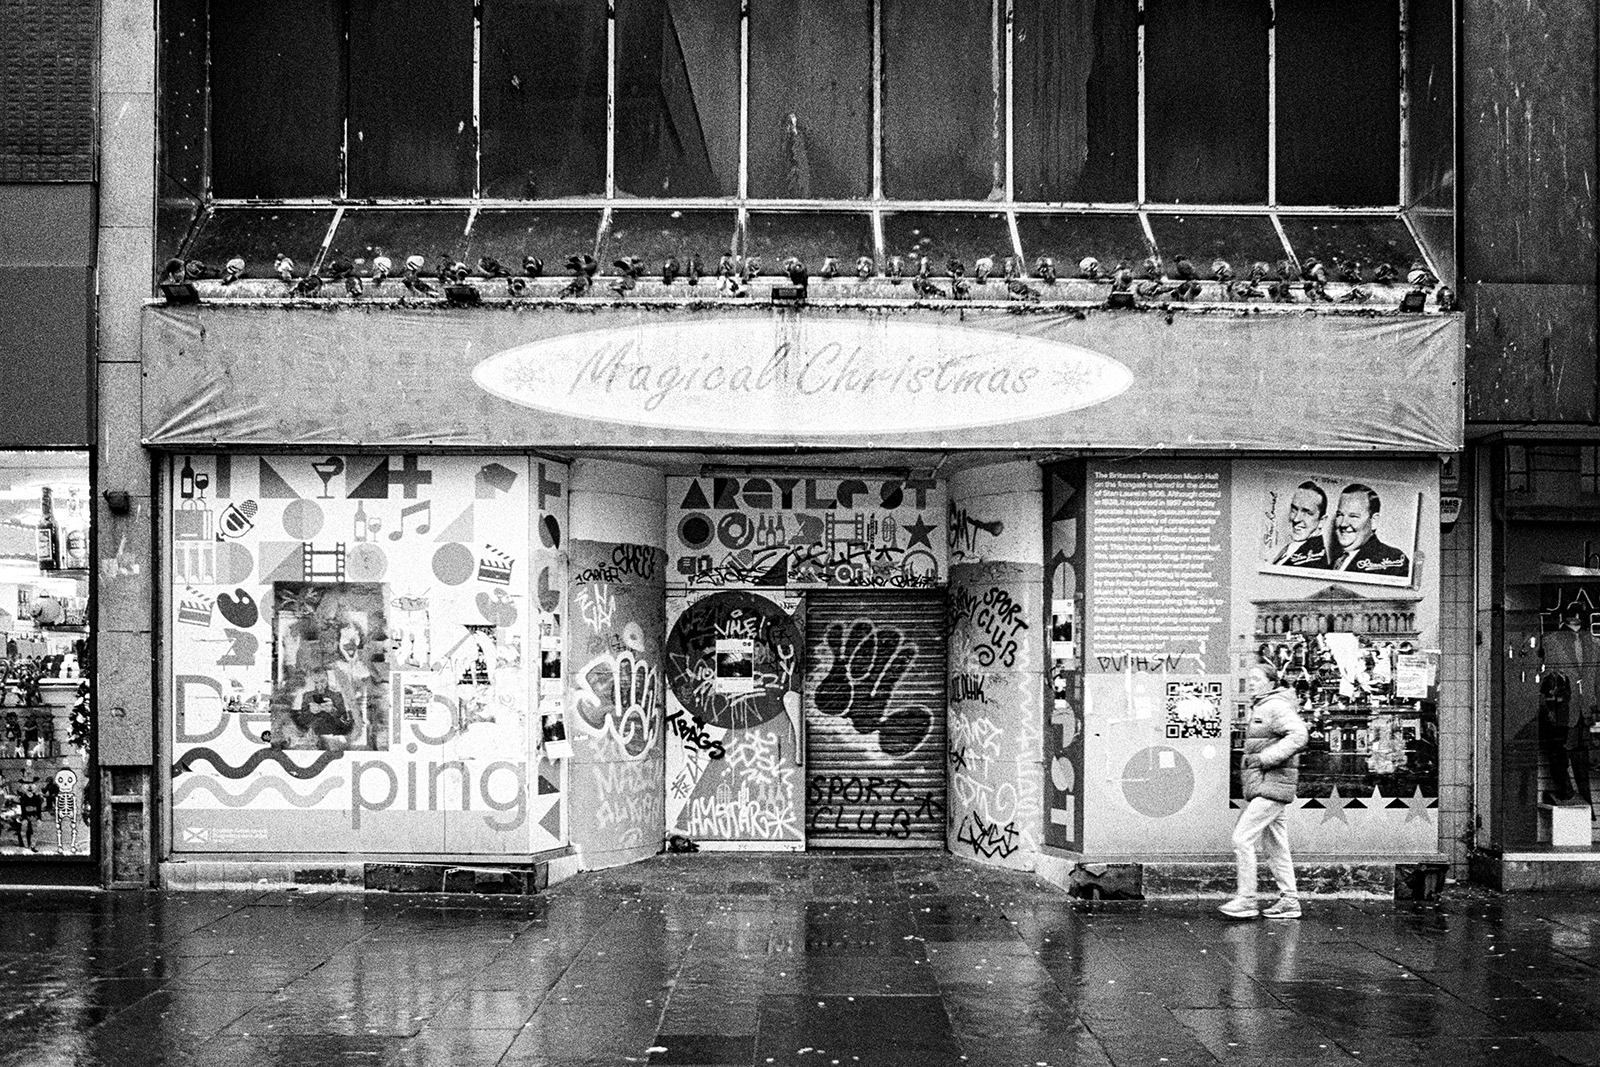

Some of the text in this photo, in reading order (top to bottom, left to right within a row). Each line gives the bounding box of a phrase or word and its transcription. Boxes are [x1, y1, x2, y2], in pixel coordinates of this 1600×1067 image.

[568, 341, 1038, 411] Magical Christmas
[1108, 471, 1141, 479] Britannia
[1141, 472, 1182, 481] Panopticon
[1182, 472, 1204, 480] Music
[1204, 472, 1219, 480] Hall
[983, 587, 1029, 637] SPORT
[978, 609, 1018, 667] CLUB
[352, 742, 526, 832] ping
[807, 775, 911, 804] SPORT
[812, 805, 911, 839] CLUB
